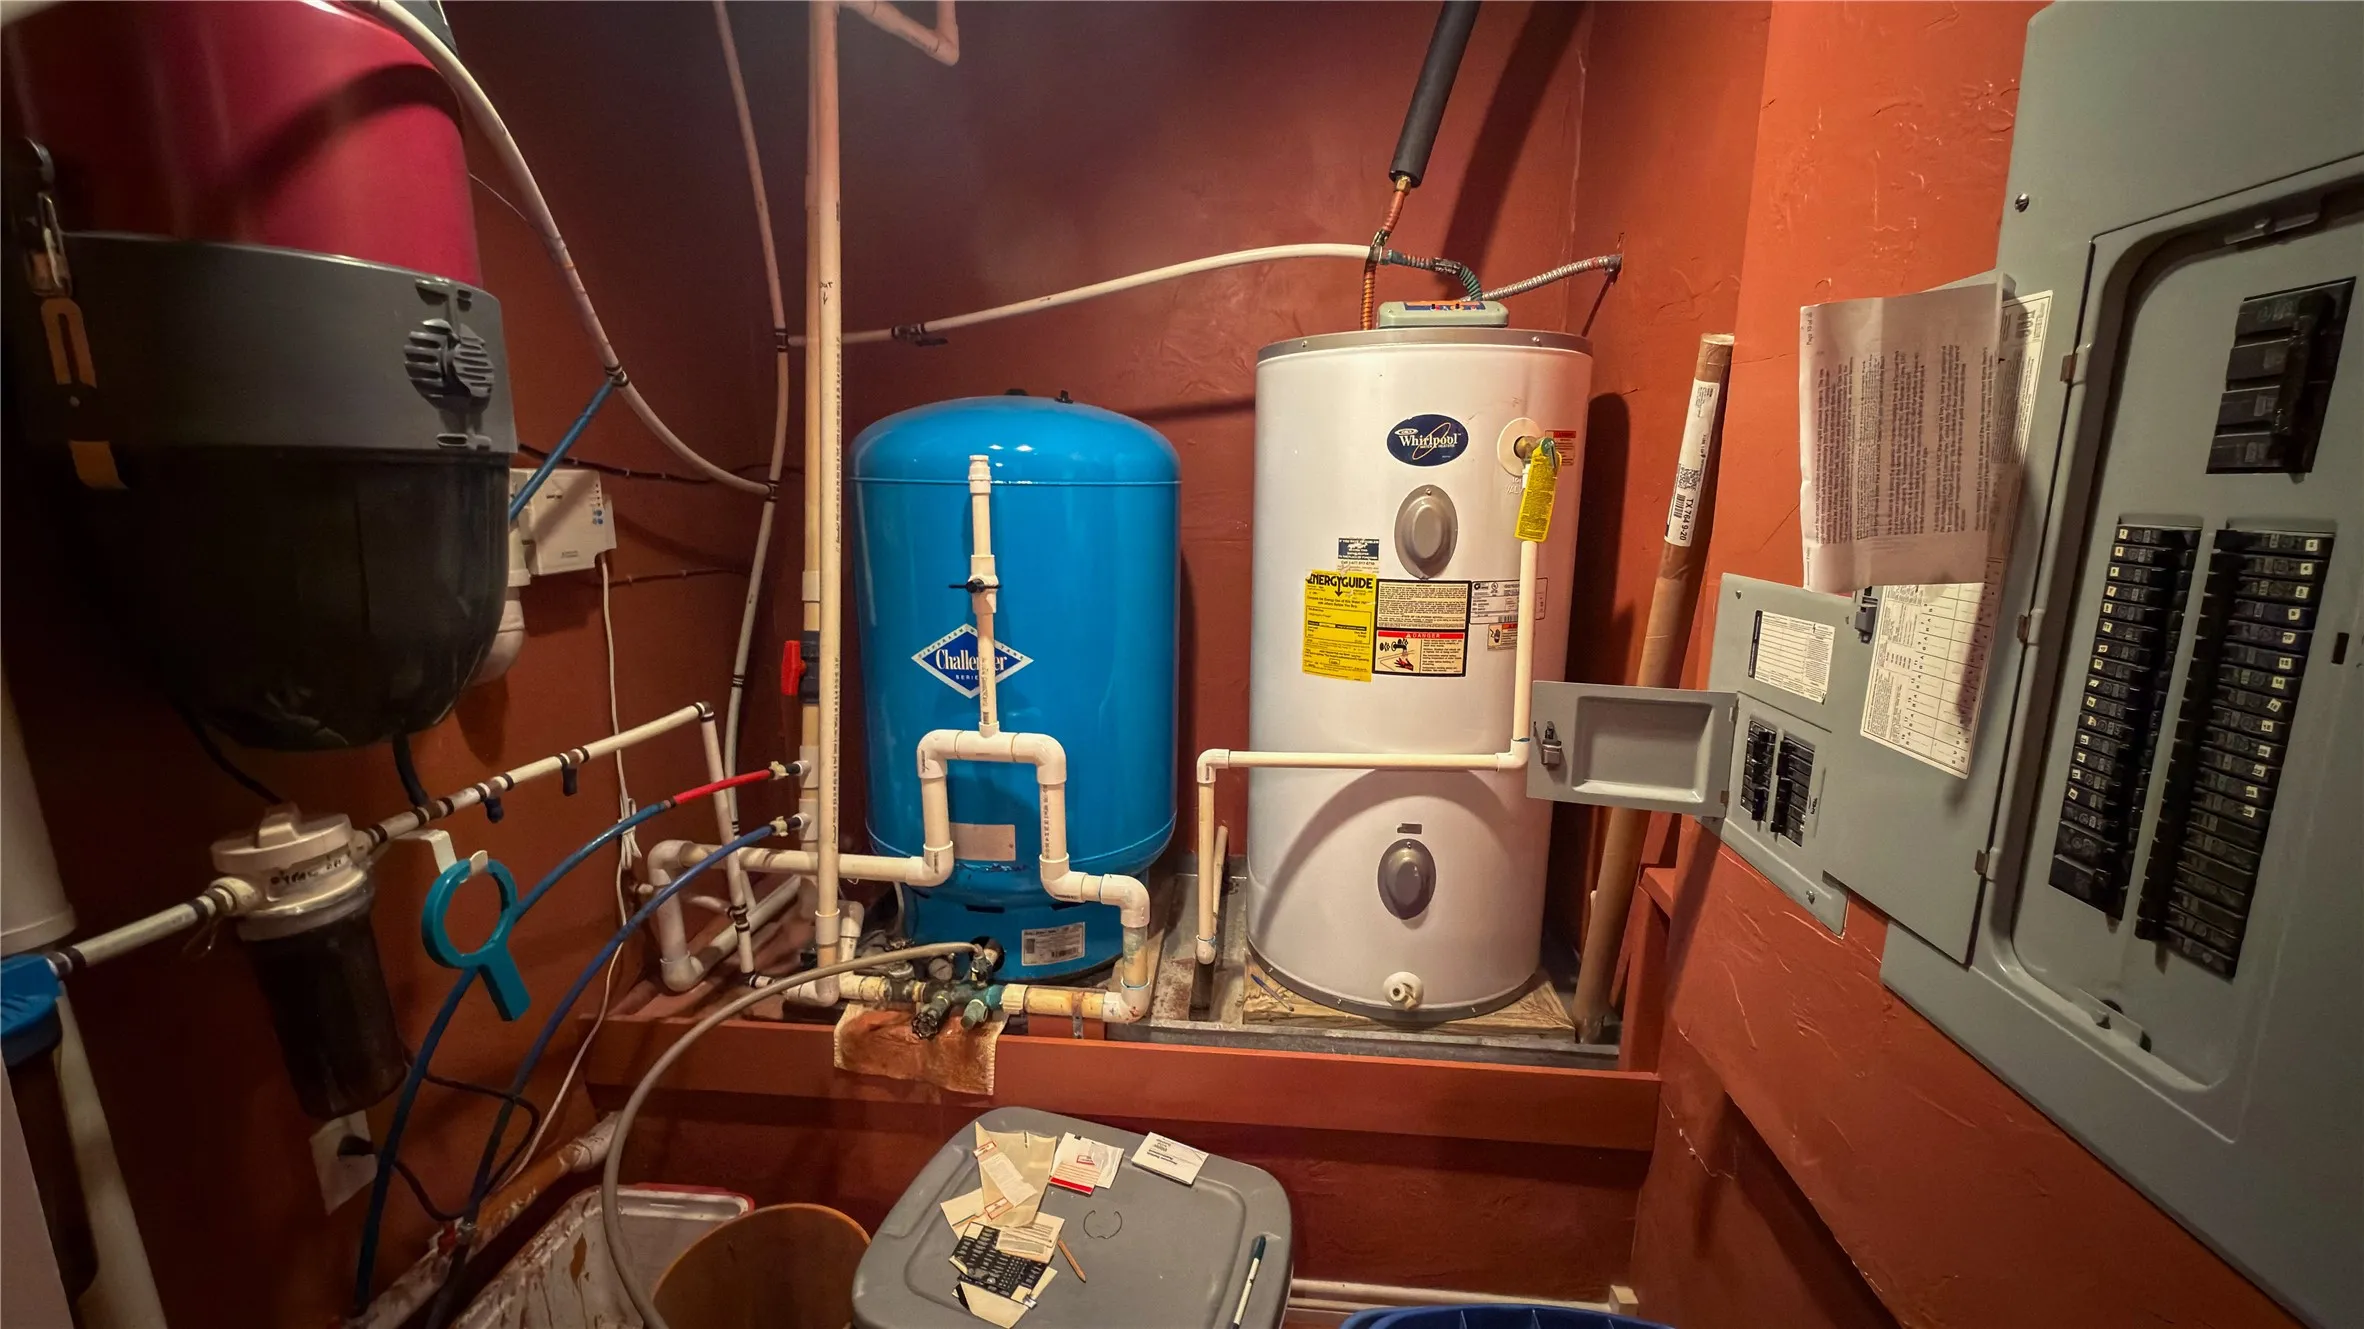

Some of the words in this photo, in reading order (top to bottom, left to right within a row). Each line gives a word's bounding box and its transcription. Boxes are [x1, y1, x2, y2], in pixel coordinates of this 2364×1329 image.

[1399, 433, 1458, 448] Whirlpool
[1686, 499, 1694, 509] TX
[1683, 510, 1692, 523] 764
[1679, 525, 1689, 540] 9-20
[935, 648, 1008, 670] Challeer
[1000, 645, 1024, 660] TANK
